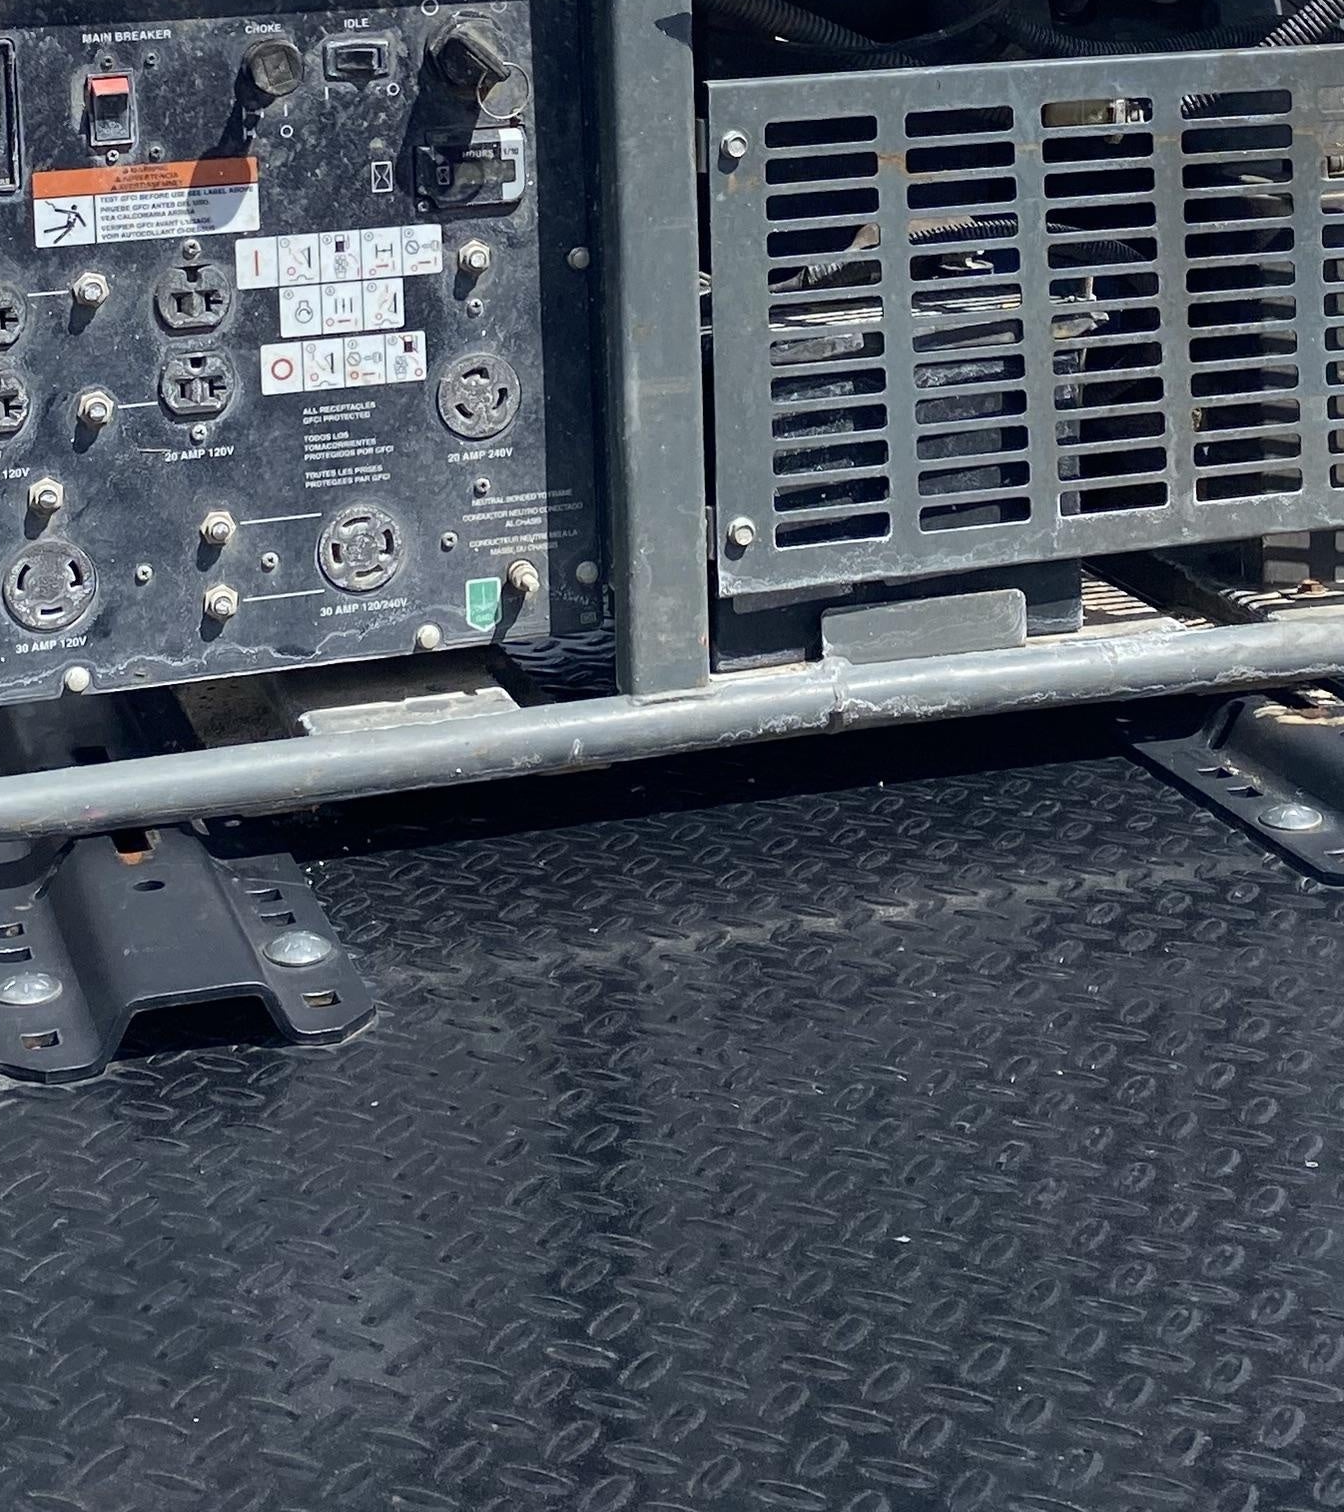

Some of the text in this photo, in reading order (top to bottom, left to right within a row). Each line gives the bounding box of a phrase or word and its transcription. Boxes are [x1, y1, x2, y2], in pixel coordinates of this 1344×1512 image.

[245, 23, 281, 34] CHOKE
[344, 18, 370, 29] IDLE
[82, 29, 172, 44] MAIN BREAKER
[303, 401, 376, 416] ALL RECEPTACLES
[303, 410, 371, 425] GFCI PROTECTED
[303, 430, 349, 443] TODOS LOS
[165, 445, 235, 462] 20 AMP 120V
[447, 447, 513, 463] 20 AMP 240V
[2, 467, 31, 480] 120V
[320, 597, 408, 617] 30 AMP 120/240V
[15, 635, 87, 654] 30 AMP 120V
